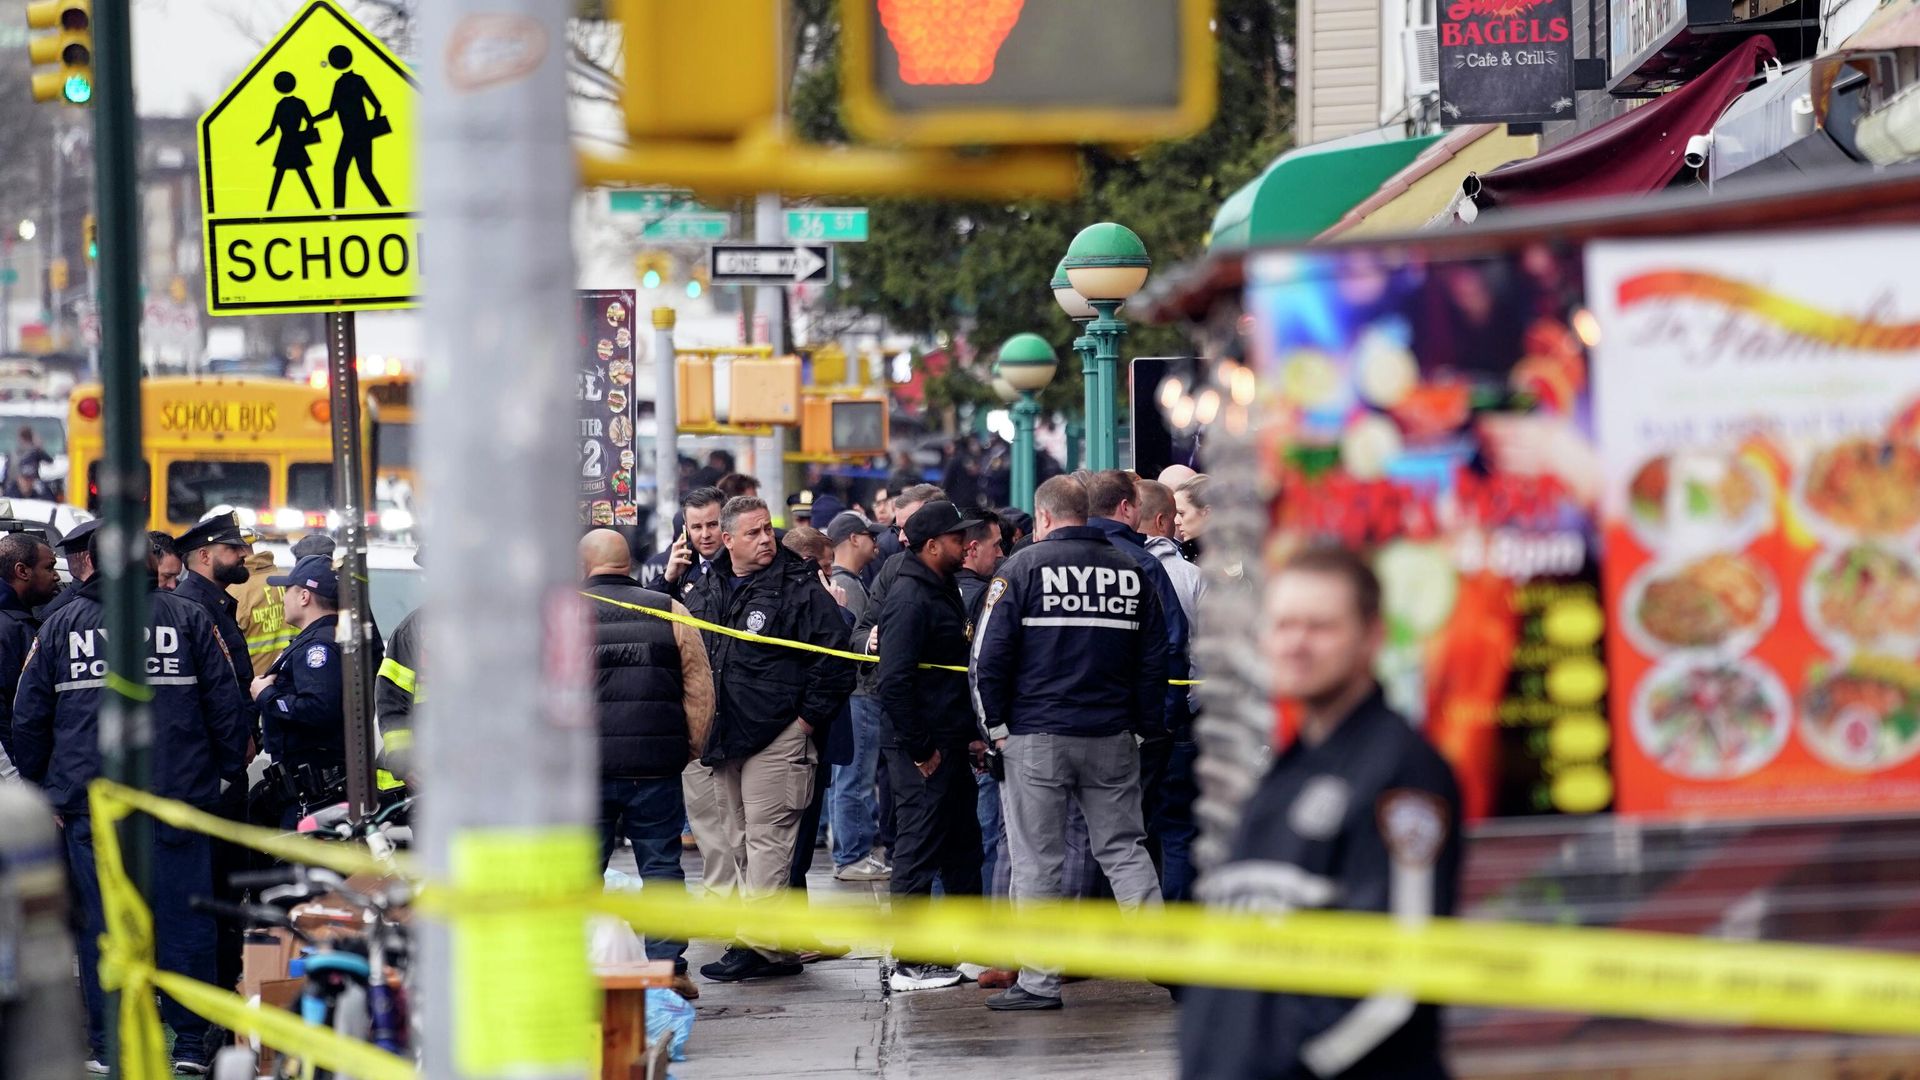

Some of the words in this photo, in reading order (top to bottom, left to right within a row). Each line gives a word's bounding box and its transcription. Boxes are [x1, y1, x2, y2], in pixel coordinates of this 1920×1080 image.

[1441, 17, 1569, 46] BAGELS
[1466, 53, 1498, 67] Cafe
[1501, 51, 1512, 66] &
[1516, 50, 1545, 65] Grill
[798, 215, 824, 238] 36
[834, 214, 855, 230] ST
[227, 233, 411, 283] SCHOO
[727, 256, 761, 273] ONE
[779, 256, 811, 273] WAY
[161, 403, 231, 431] SCHOOL
[239, 404, 276, 432] BUS
[1041, 566, 1141, 597] NYPD
[1043, 595, 1139, 615] POLICE
[69, 626, 179, 659] ND
[70, 657, 180, 679] POCE
